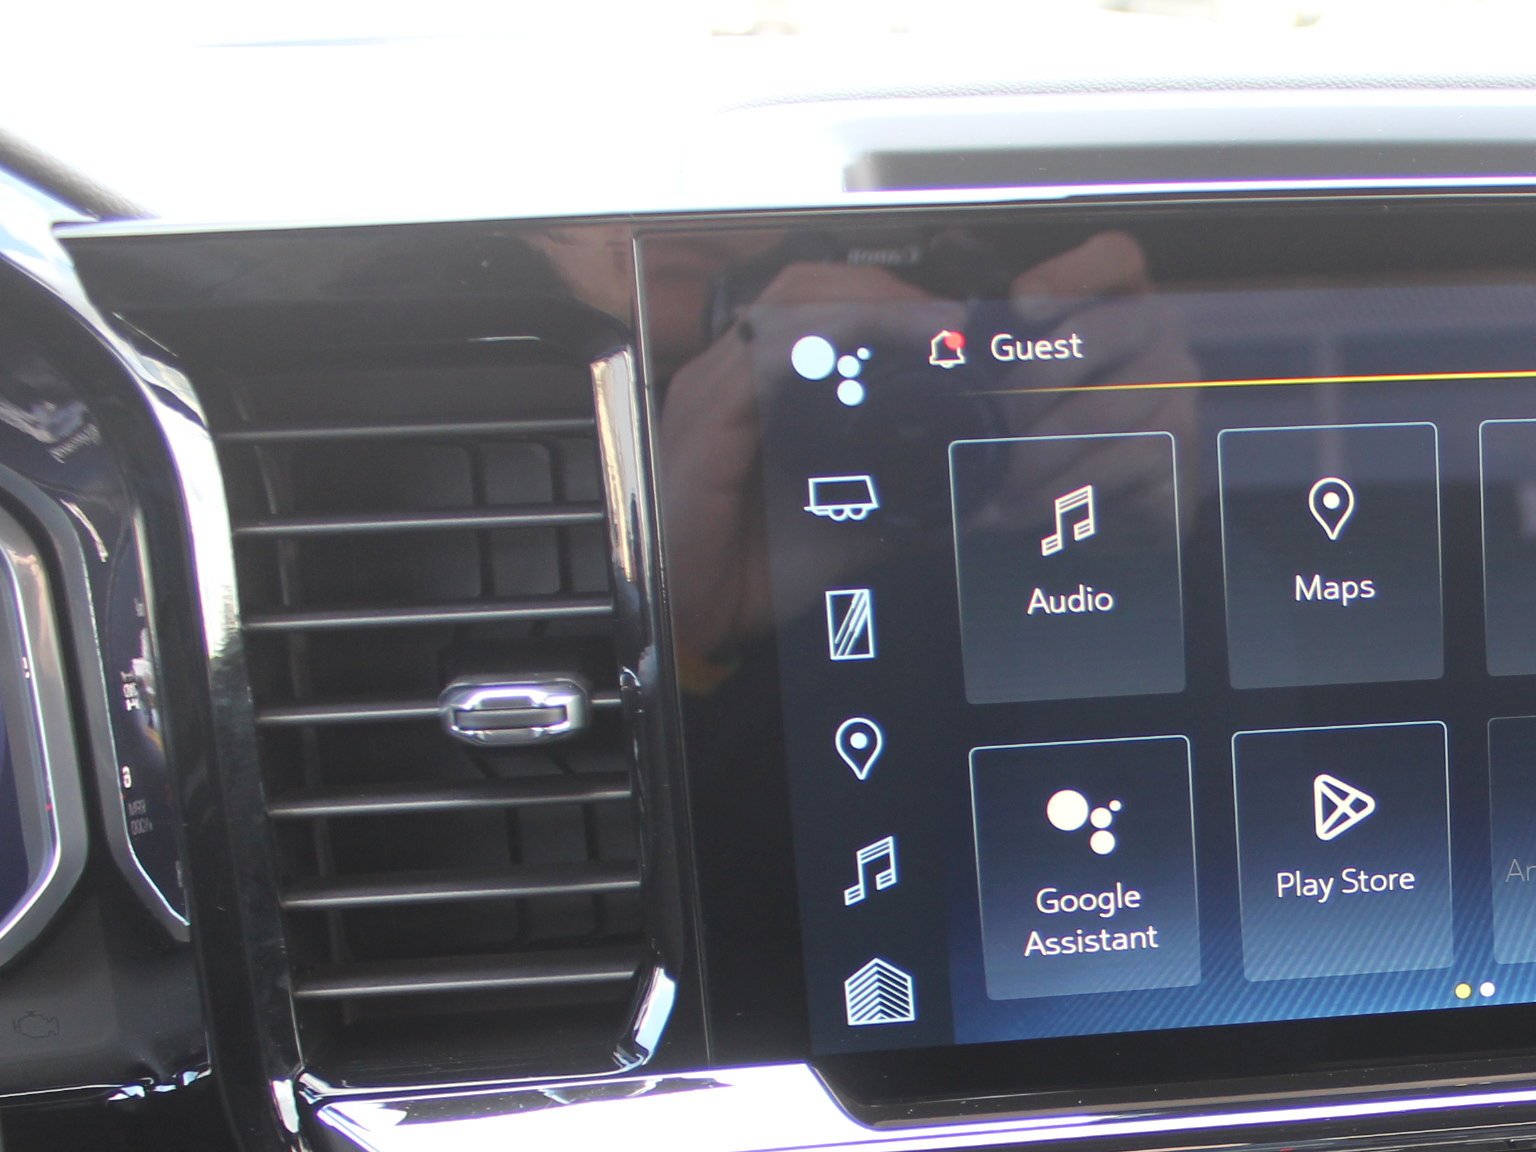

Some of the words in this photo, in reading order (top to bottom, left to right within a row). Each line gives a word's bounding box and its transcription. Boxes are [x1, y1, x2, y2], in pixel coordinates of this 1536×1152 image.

[990, 332, 1084, 361] Guest
[1027, 585, 1114, 617] Audio
[1293, 573, 1375, 606] Maps
[1275, 869, 1336, 902] Play
[1341, 865, 1416, 894] Store
[1035, 883, 1142, 919] Google
[1023, 925, 1160, 958] Assistant
